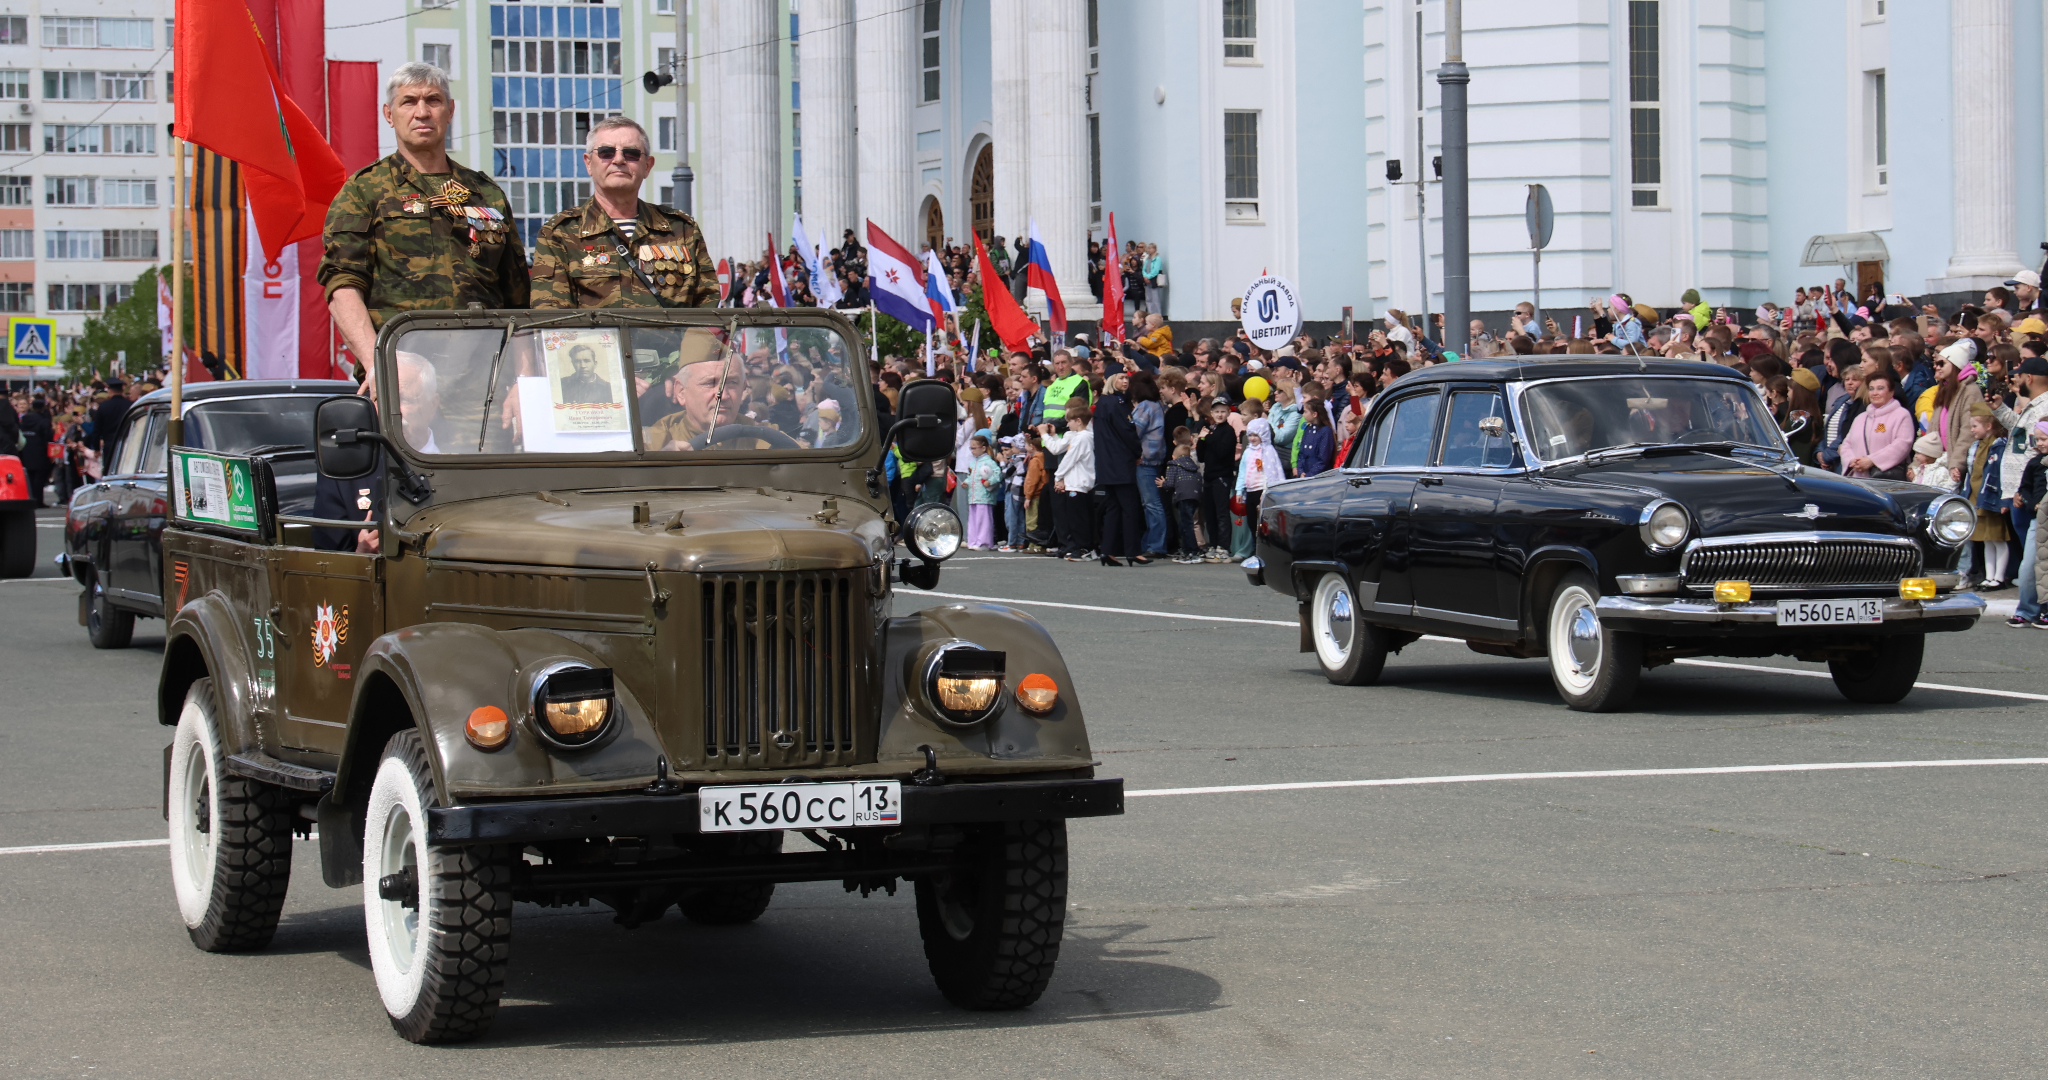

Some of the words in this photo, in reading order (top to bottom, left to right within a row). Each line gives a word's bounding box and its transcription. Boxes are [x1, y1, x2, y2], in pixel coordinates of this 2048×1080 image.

[1242, 277, 1276, 313] КАБЕЛЬНЫЙ
[1276, 280, 1295, 308] ЗАВОД
[1251, 325, 1293, 340] ЦВЕТЛИТ
[1861, 601, 1876, 615] 13
[254, 617, 274, 659] 35
[859, 785, 889, 811] 13
[855, 812, 879, 822] RUS
